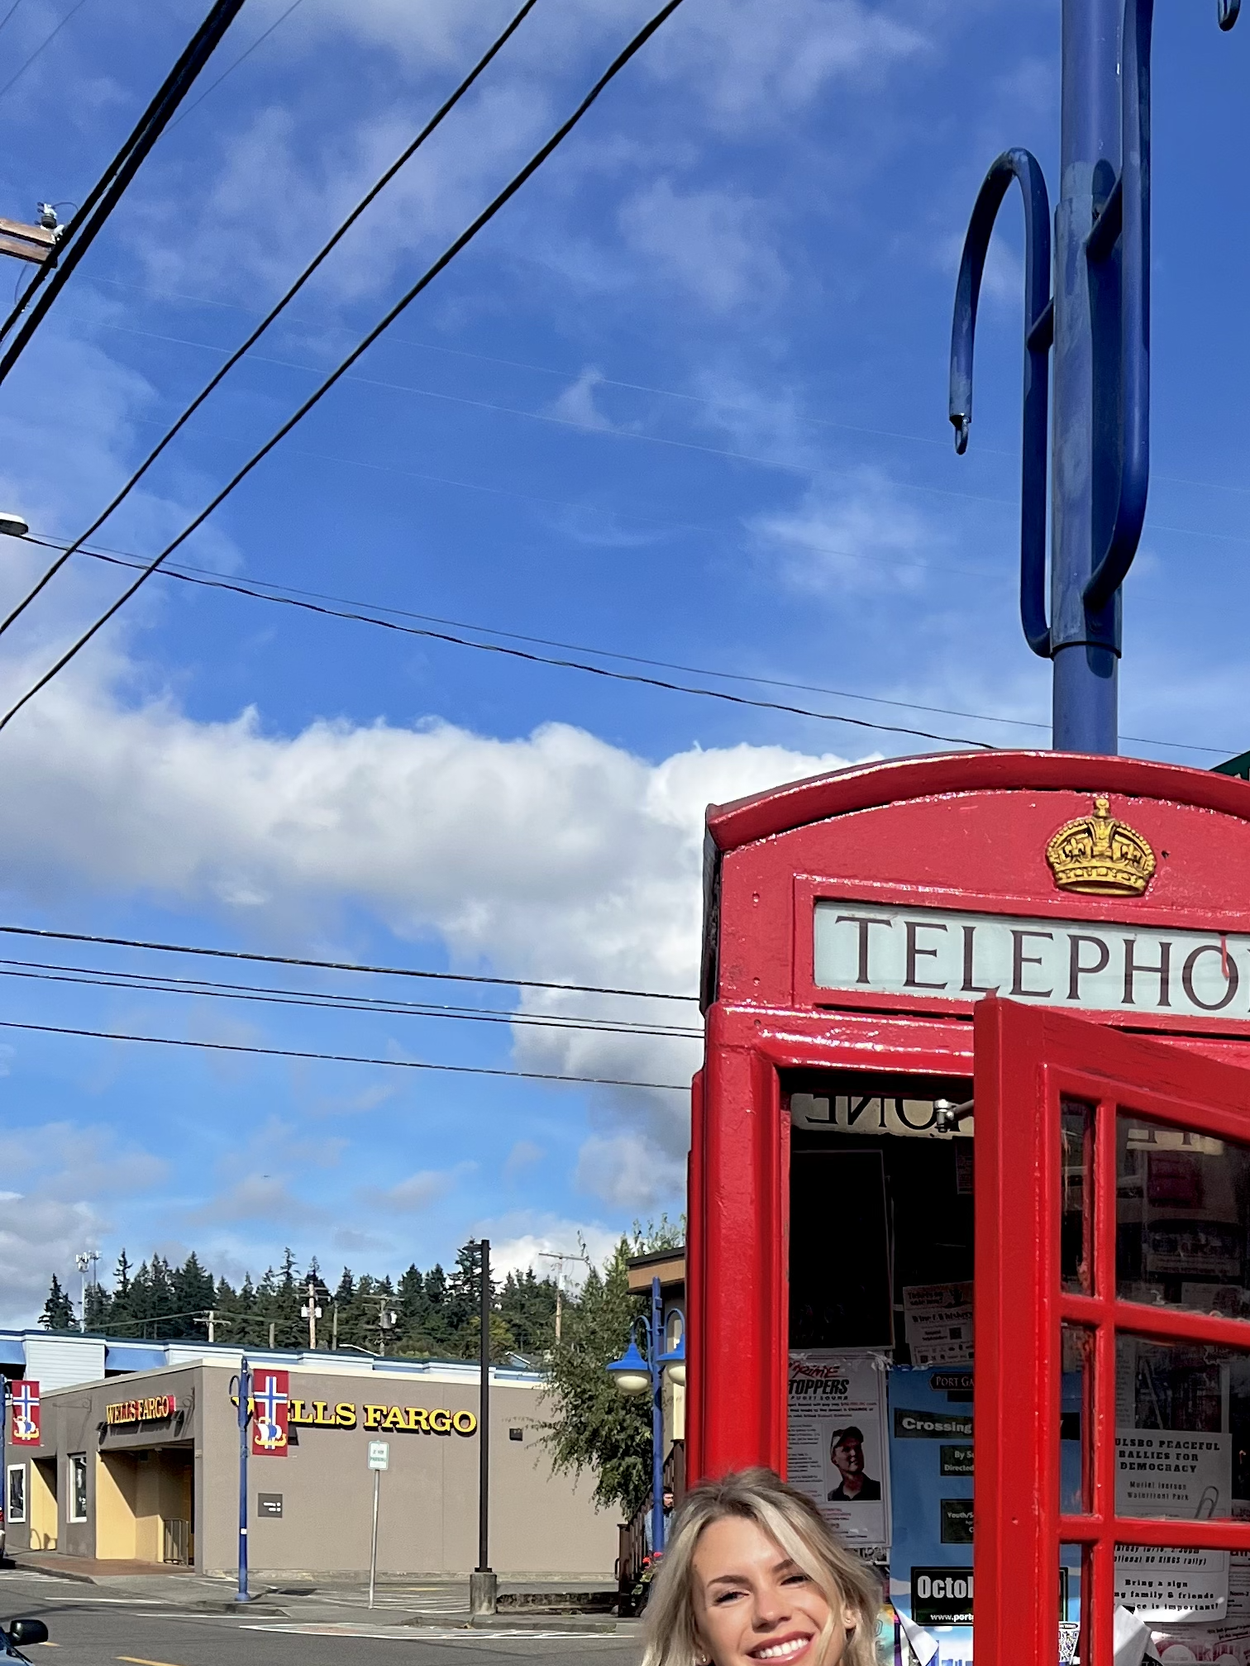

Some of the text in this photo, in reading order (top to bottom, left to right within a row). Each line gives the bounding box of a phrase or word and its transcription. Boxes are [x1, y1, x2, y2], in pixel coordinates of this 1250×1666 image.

[787, 1379, 850, 1395] TOPPERS
[935, 1377, 958, 1387] PORT
[106, 1395, 169, 1425] WELLS FARGO
[363, 1404, 477, 1433] FARGO
[902, 1417, 972, 1434] Crossing
[1115, 1438, 1221, 1451] ULSBO PEACEFUL
[954, 1450, 965, 1460] By
[1175, 1453, 1199, 1462] FOR
[1120, 1462, 1197, 1473] DEMOCRACY
[917, 1575, 974, 1599] Octo
[1125, 1579, 1154, 1588] Bring
[1167, 1580, 1188, 1588] sign
[1130, 1591, 1163, 1599] family
